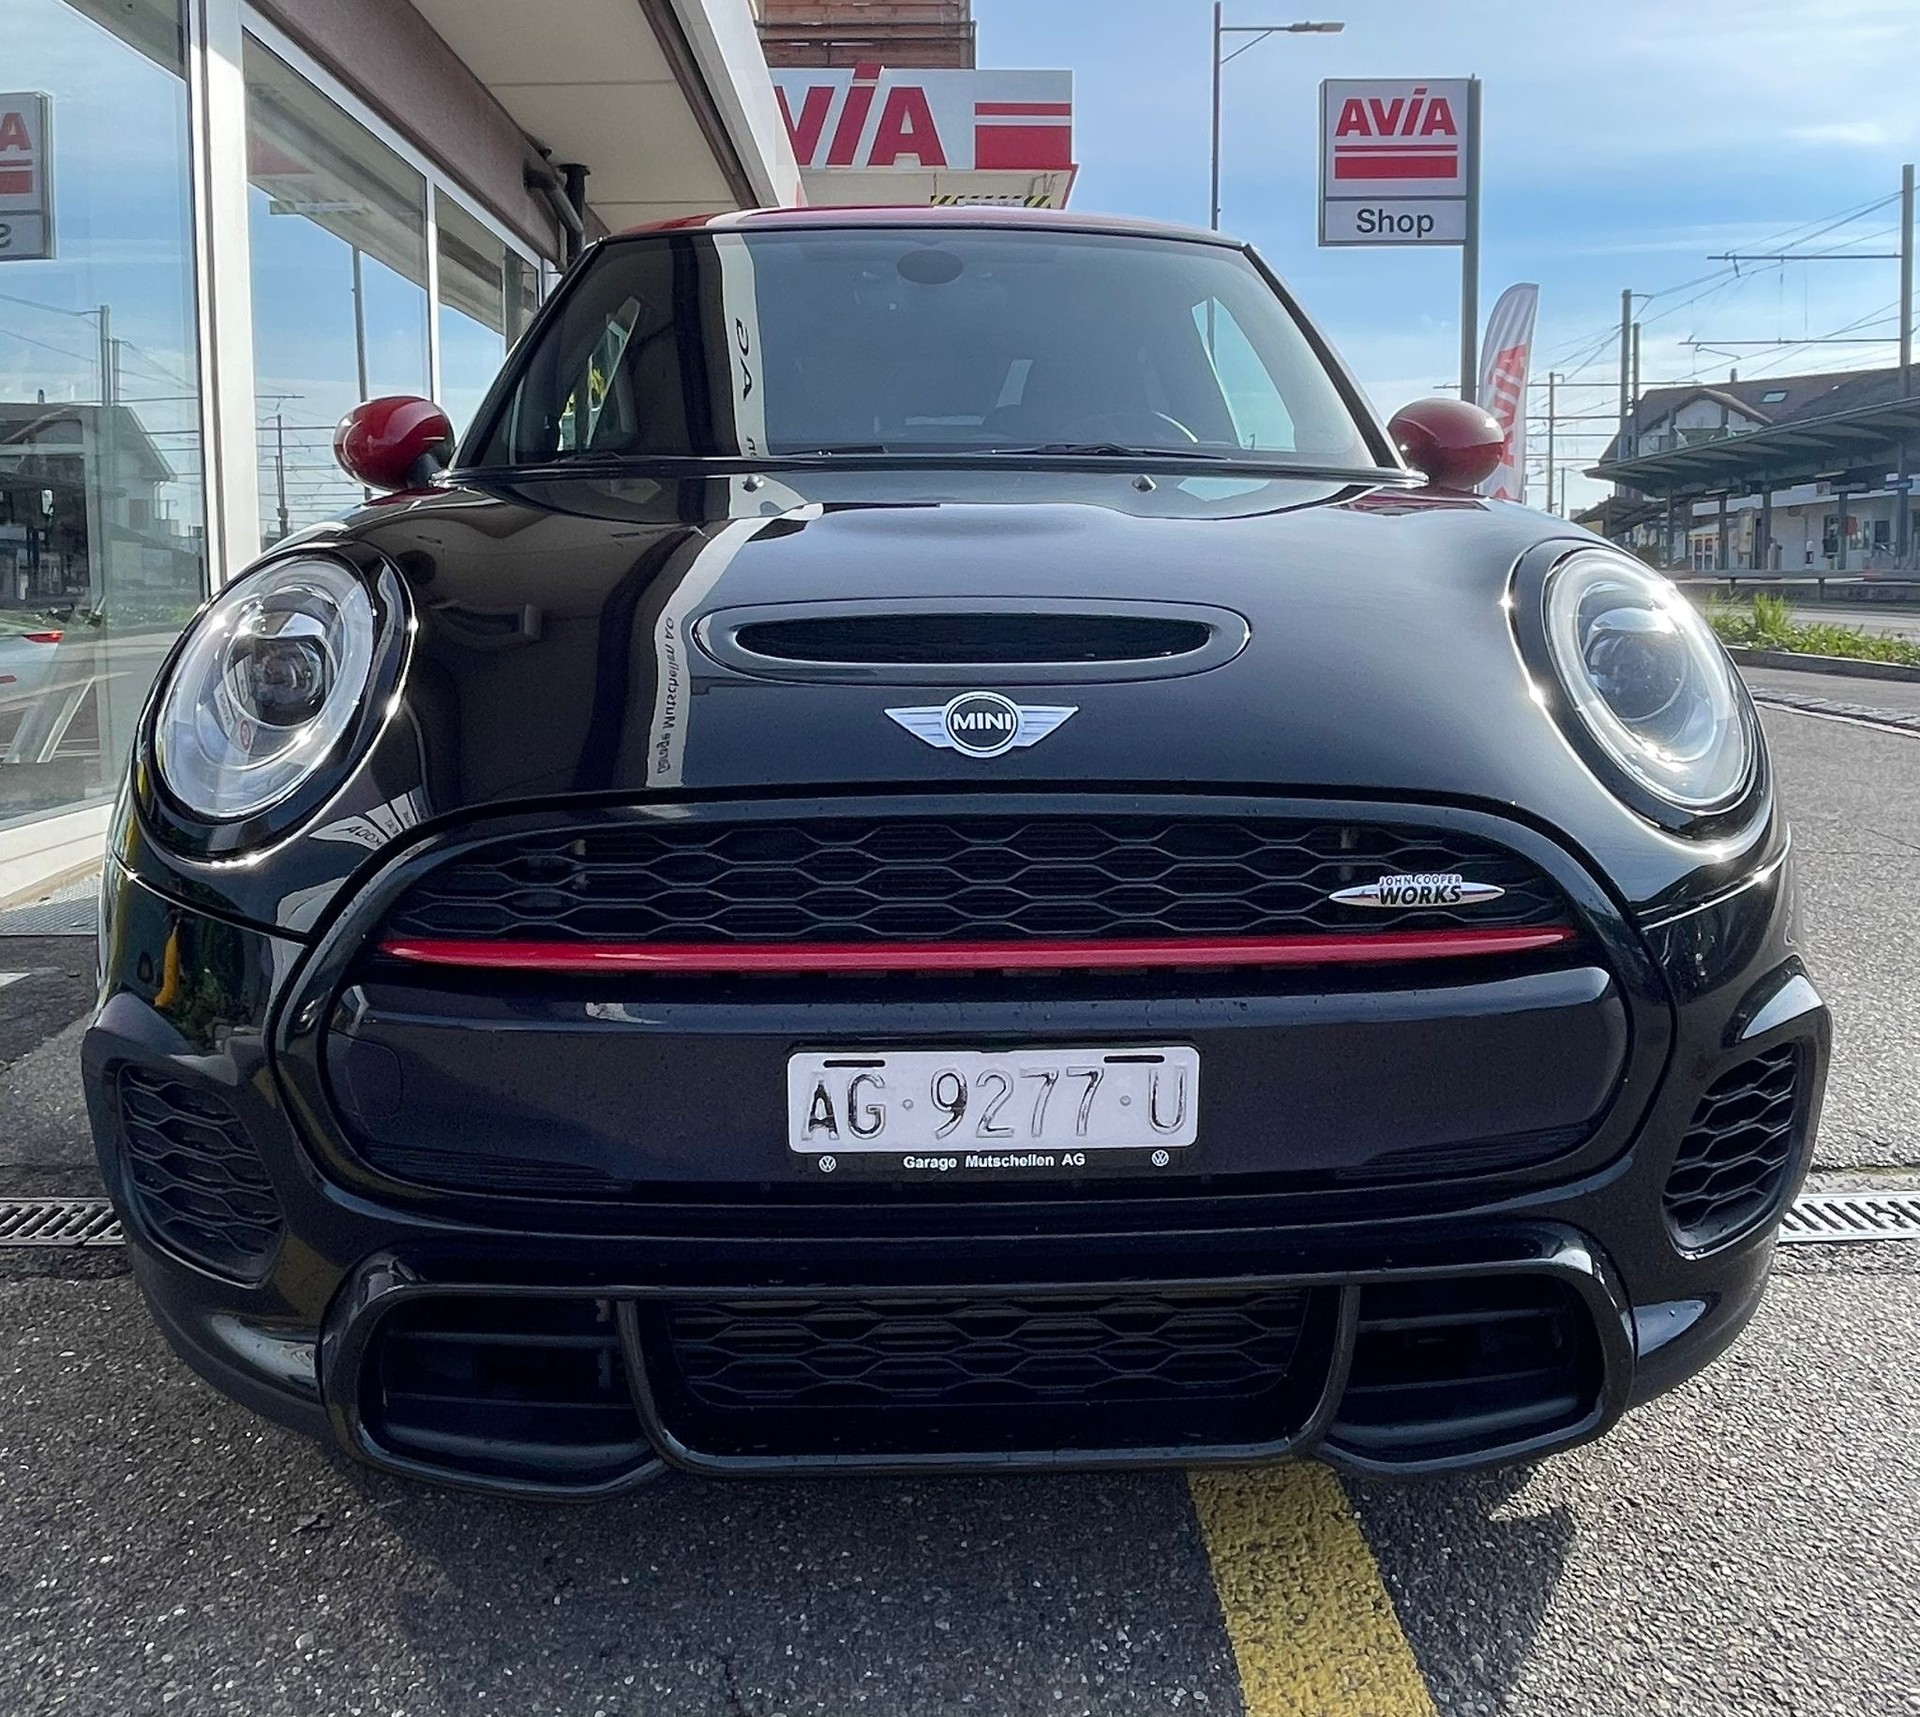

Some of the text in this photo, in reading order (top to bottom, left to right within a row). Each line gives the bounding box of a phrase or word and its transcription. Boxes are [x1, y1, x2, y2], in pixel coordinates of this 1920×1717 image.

[774, 62, 947, 166] VIA
[1335, 88, 1457, 136] AVIA
[1356, 208, 1434, 238] Shop
[953, 712, 1012, 731] MINI
[1379, 874, 1462, 887] JOHN COOPER
[1379, 885, 1462, 905] WORKS
[801, 1065, 1187, 1141] AG 9277 U
[903, 1152, 1086, 1171] Garage Mutschellen AG
